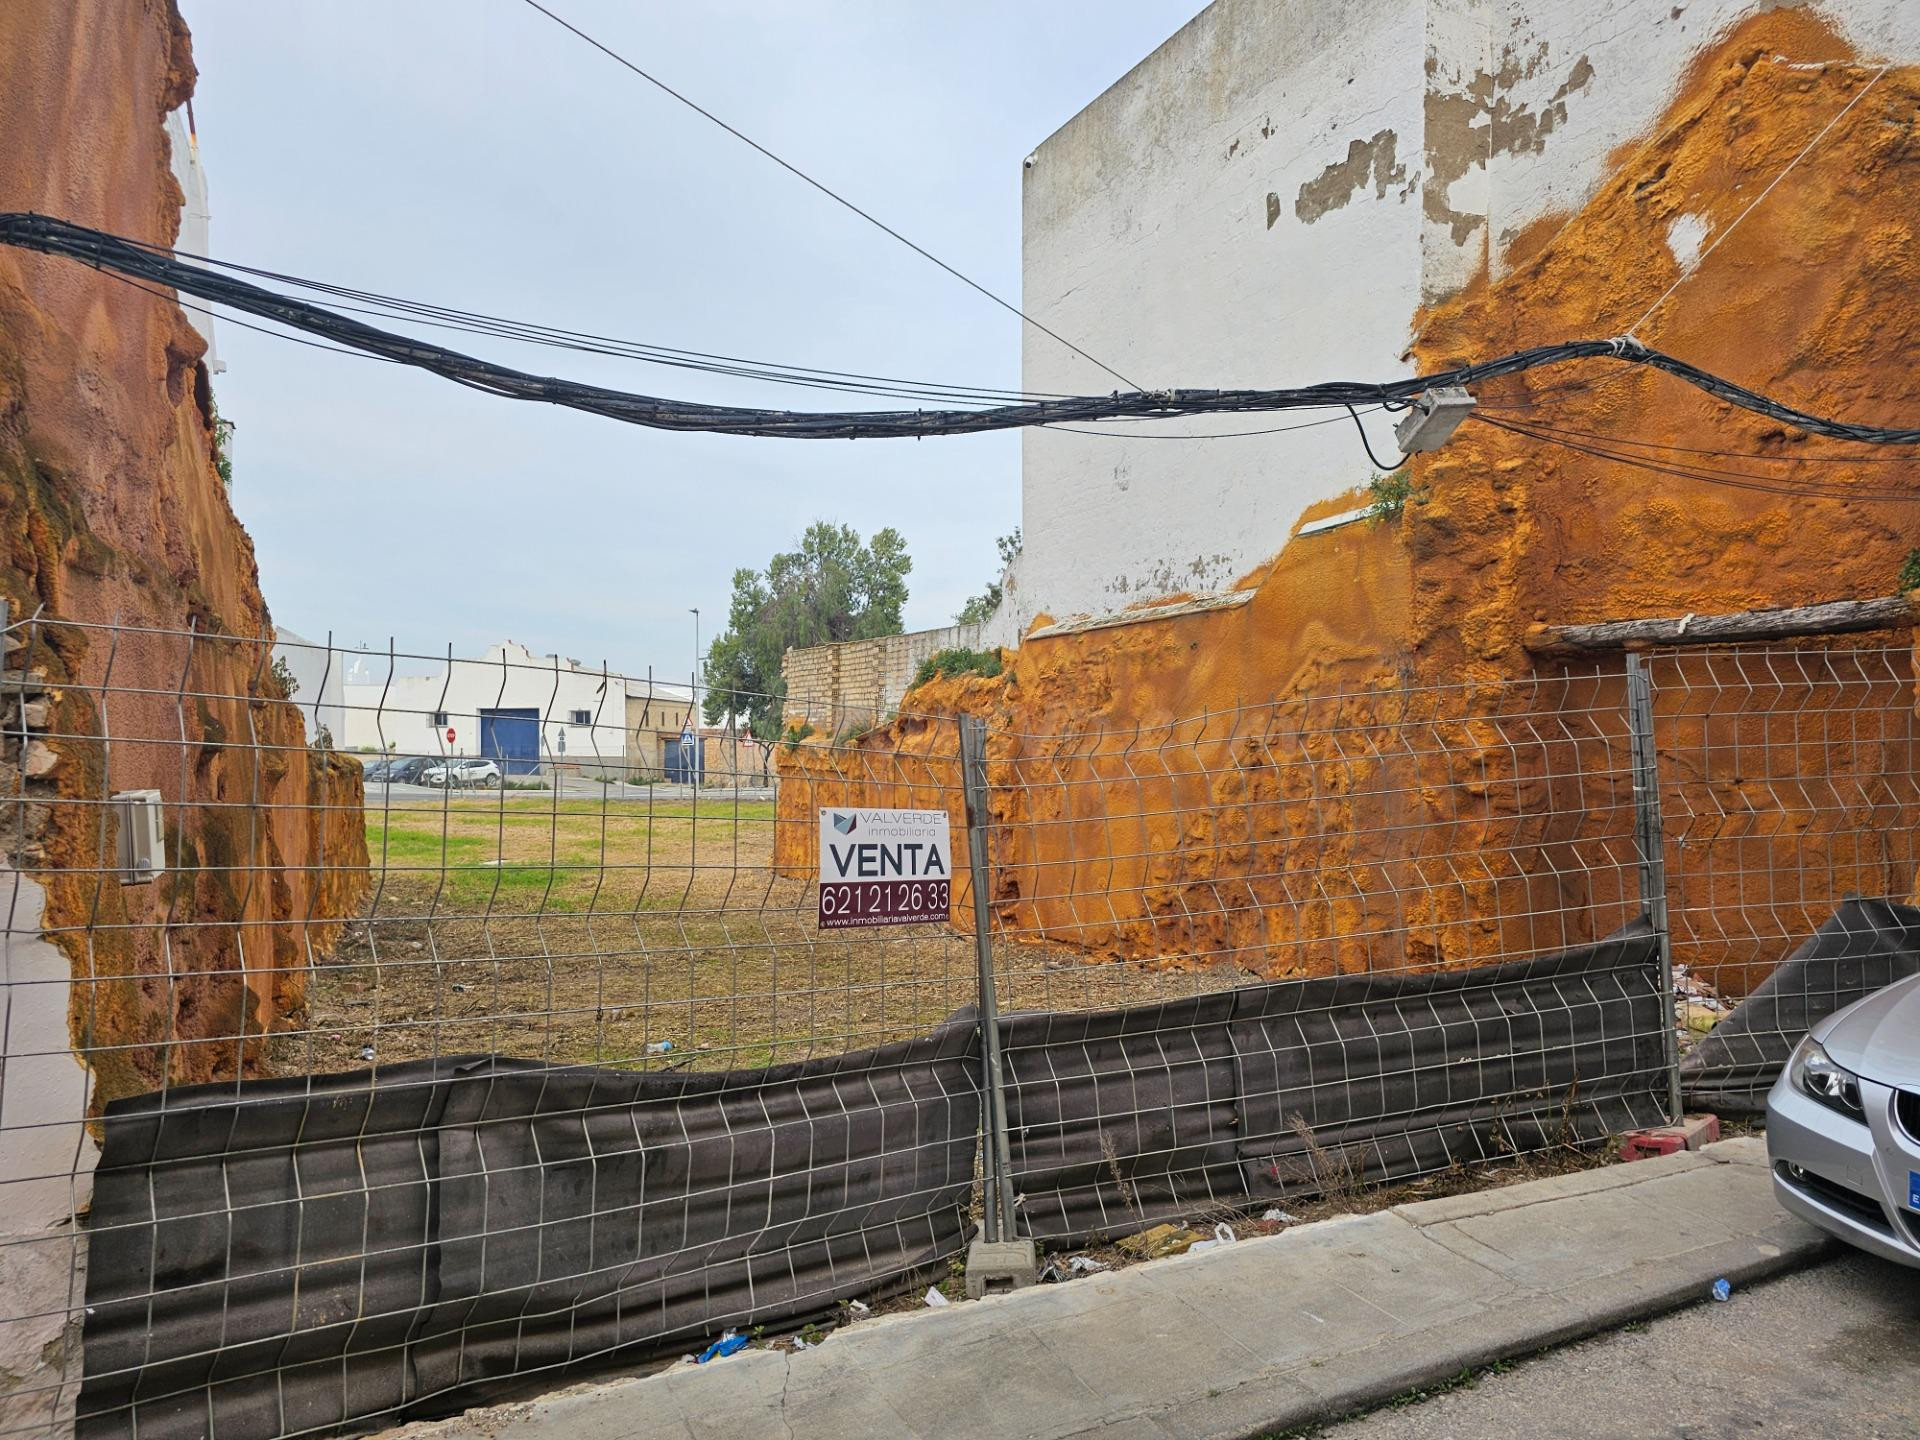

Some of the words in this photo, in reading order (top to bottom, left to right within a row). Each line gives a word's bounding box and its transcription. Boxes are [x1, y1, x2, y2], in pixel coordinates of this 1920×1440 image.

[860, 812, 942, 825] VALVERDE
[868, 826, 936, 837] inmobiliaria
[829, 843, 945, 877] VENTA
[822, 886, 862, 915] 621
[869, 884, 892, 913] 21
[898, 883, 922, 911] 26
[928, 882, 949, 910] 33
[826, 913, 946, 926] www.inmobiliariavalverde.com
